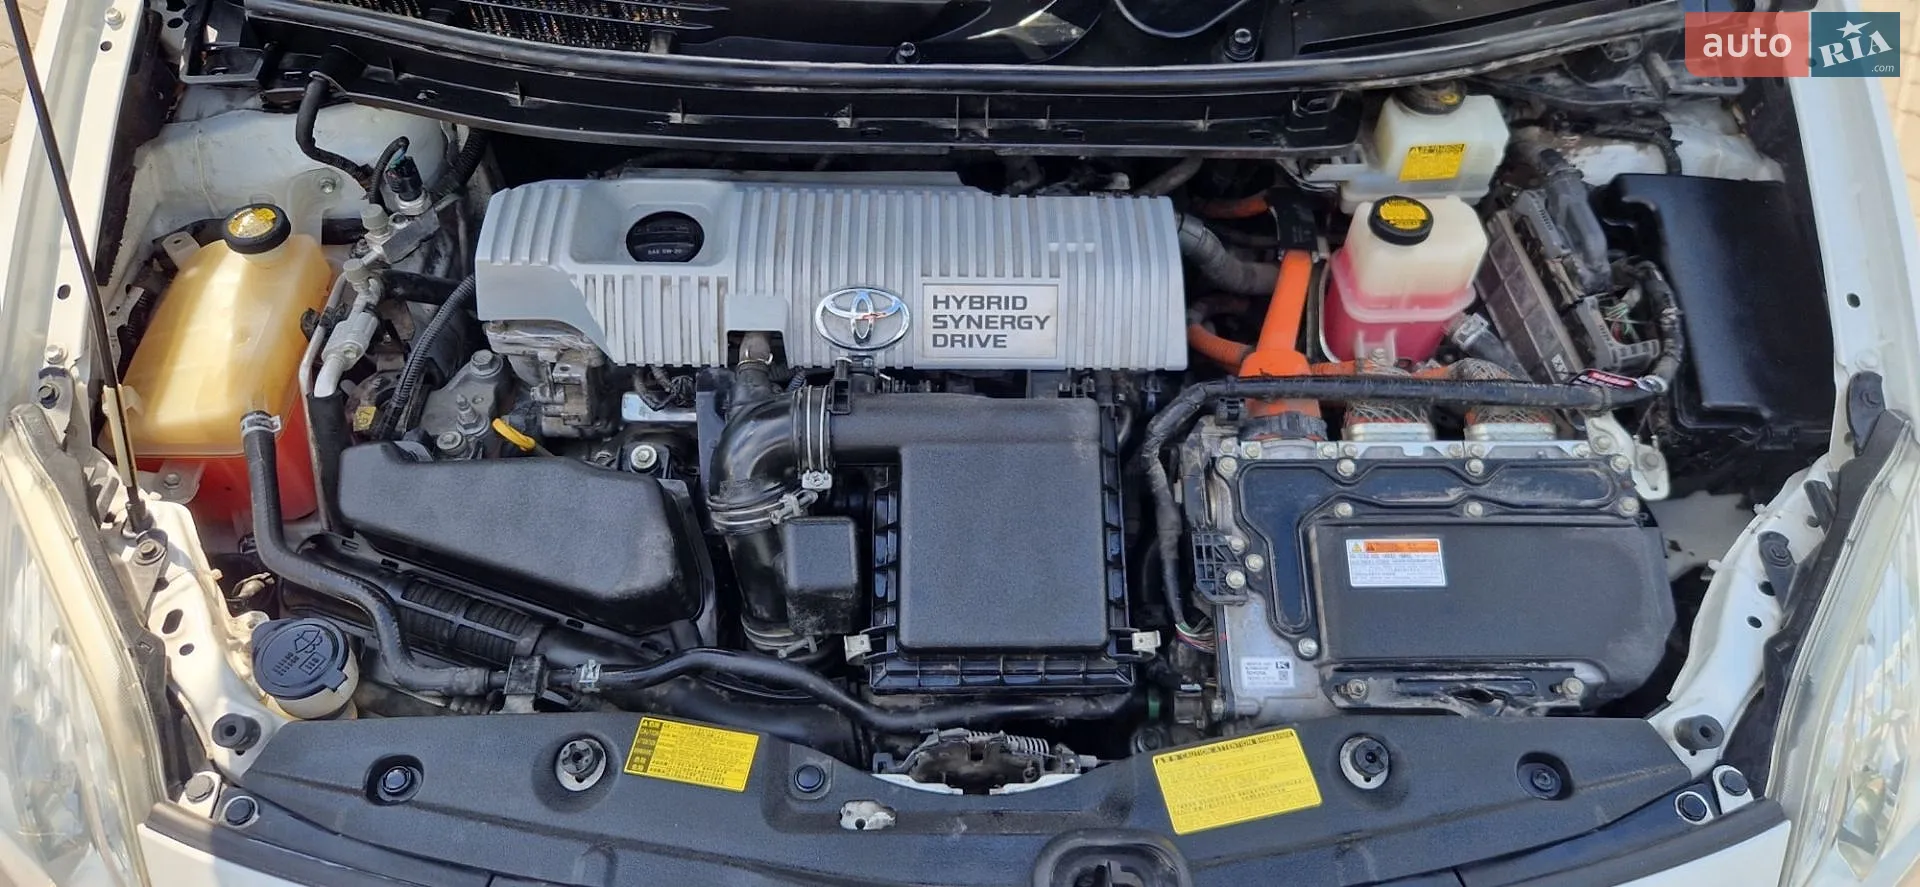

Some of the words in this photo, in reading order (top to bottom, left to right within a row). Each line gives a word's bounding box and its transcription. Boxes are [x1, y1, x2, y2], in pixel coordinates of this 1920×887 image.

[932, 295, 1028, 310] HYBRID
[932, 314, 1051, 330] SYNERGY
[932, 333, 1008, 348] DRIVE
